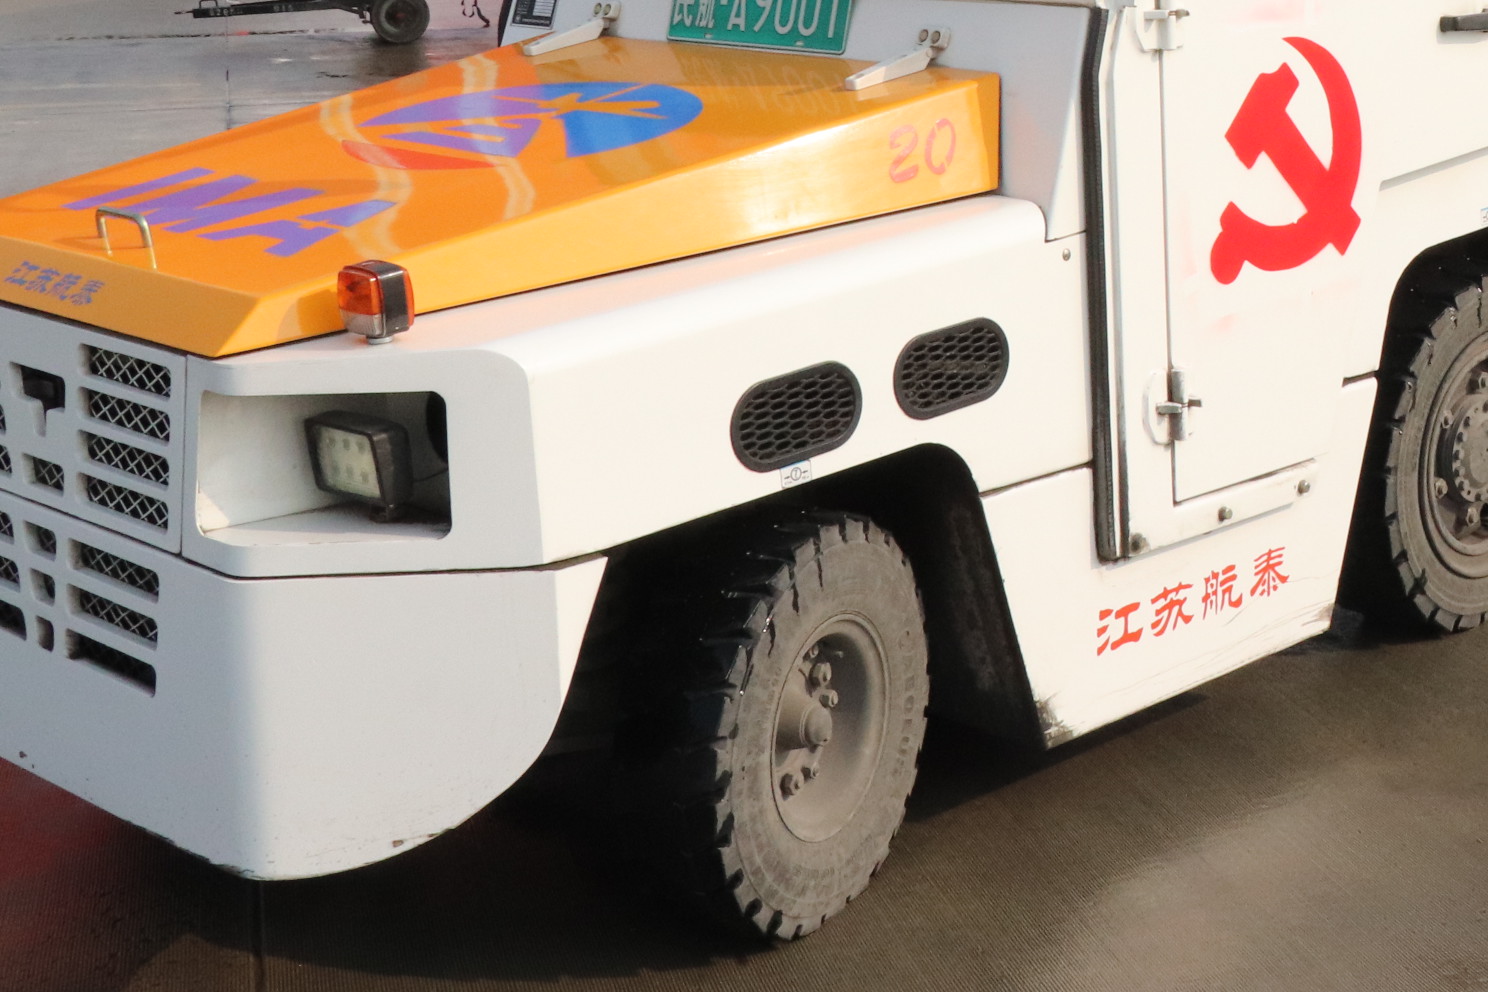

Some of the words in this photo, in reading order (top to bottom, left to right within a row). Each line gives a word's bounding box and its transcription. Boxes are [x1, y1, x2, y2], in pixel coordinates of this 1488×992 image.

[889, 118, 956, 183] 20
[1096, 546, 1290, 657] 江苏航泰
